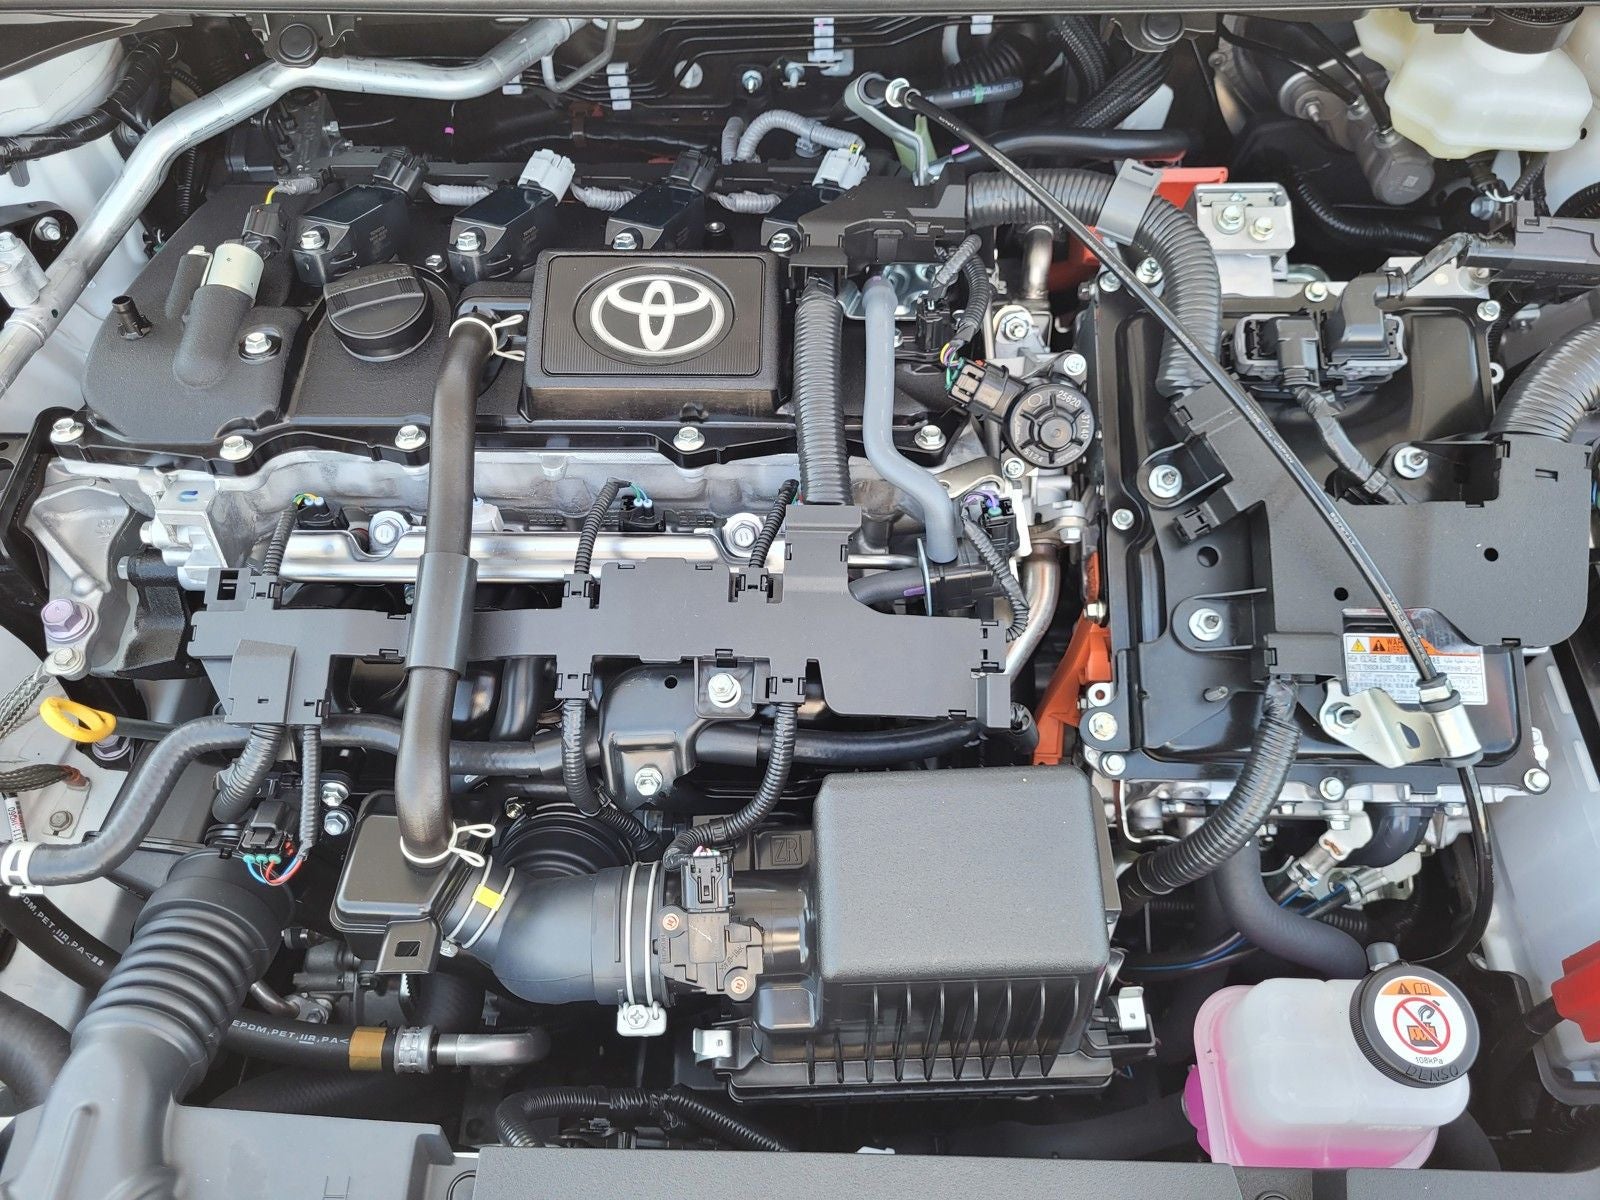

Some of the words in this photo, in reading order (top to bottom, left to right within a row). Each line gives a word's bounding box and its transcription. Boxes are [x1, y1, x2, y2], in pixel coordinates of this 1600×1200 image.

[1080, 411, 1091, 440] 37140
[1274, 441, 1294, 463] JAPAN
[771, 837, 798, 862] ZR
[1415, 1056, 1443, 1066] 108kPa
[1406, 1065, 1459, 1081] DENSO
